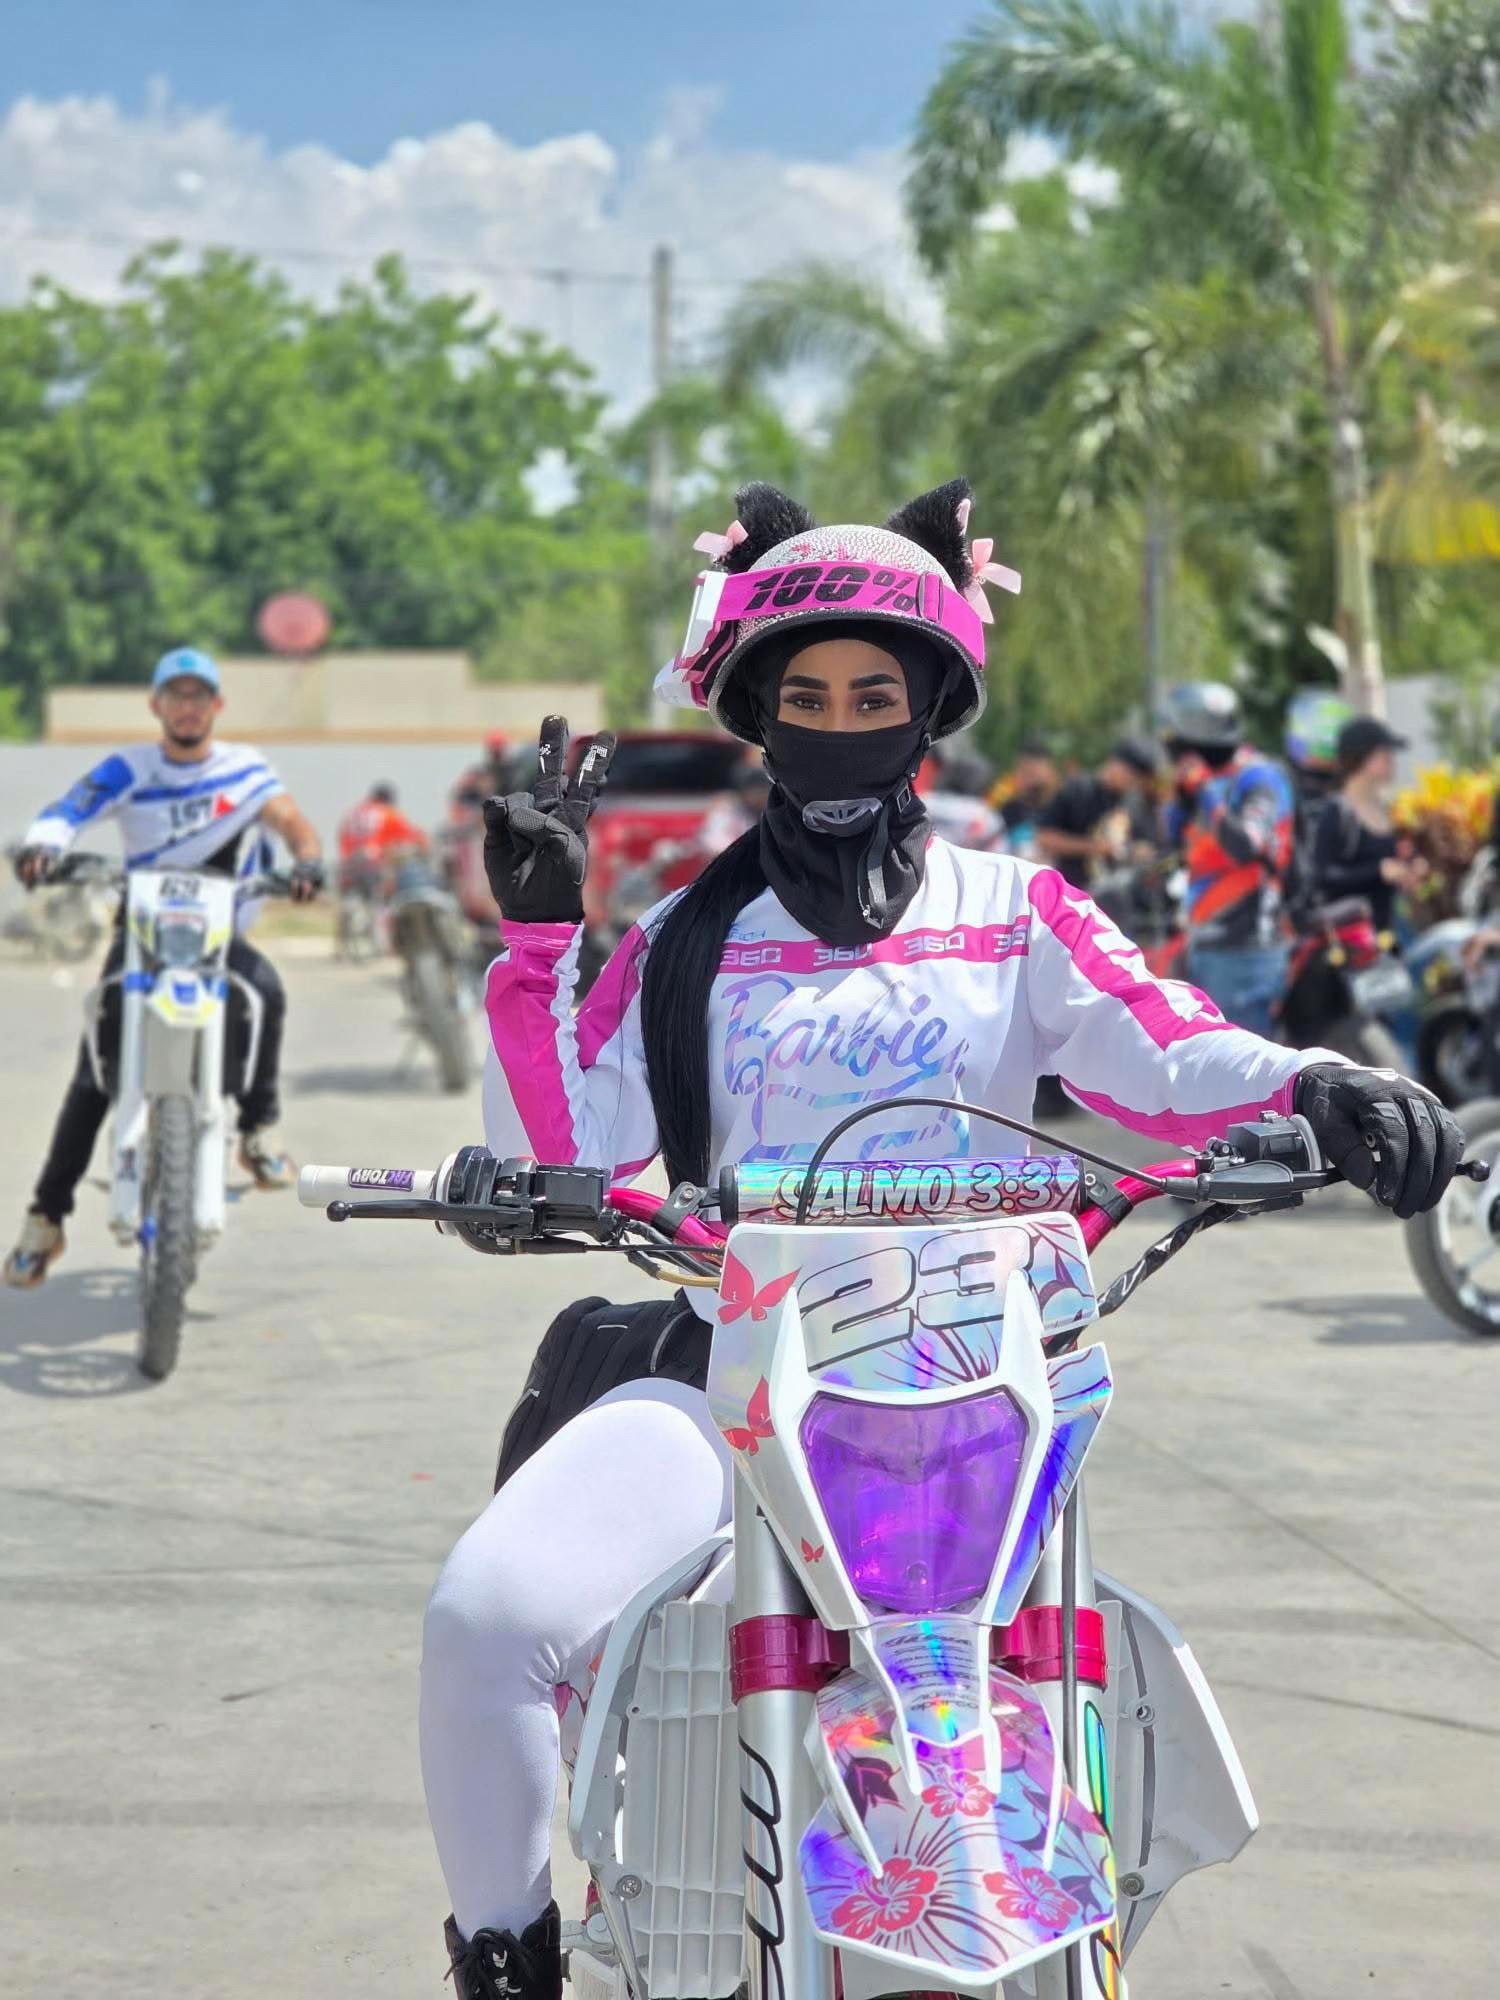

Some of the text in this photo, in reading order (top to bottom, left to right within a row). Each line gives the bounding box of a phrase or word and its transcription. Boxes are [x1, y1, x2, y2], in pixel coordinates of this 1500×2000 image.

[743, 565, 916, 612] 100%
[720, 947, 783, 967] 360
[902, 931, 966, 957] 360
[720, 972, 949, 1096] Barbie
[774, 1163, 955, 1219] SALMO
[797, 1226, 1034, 1373] 23
